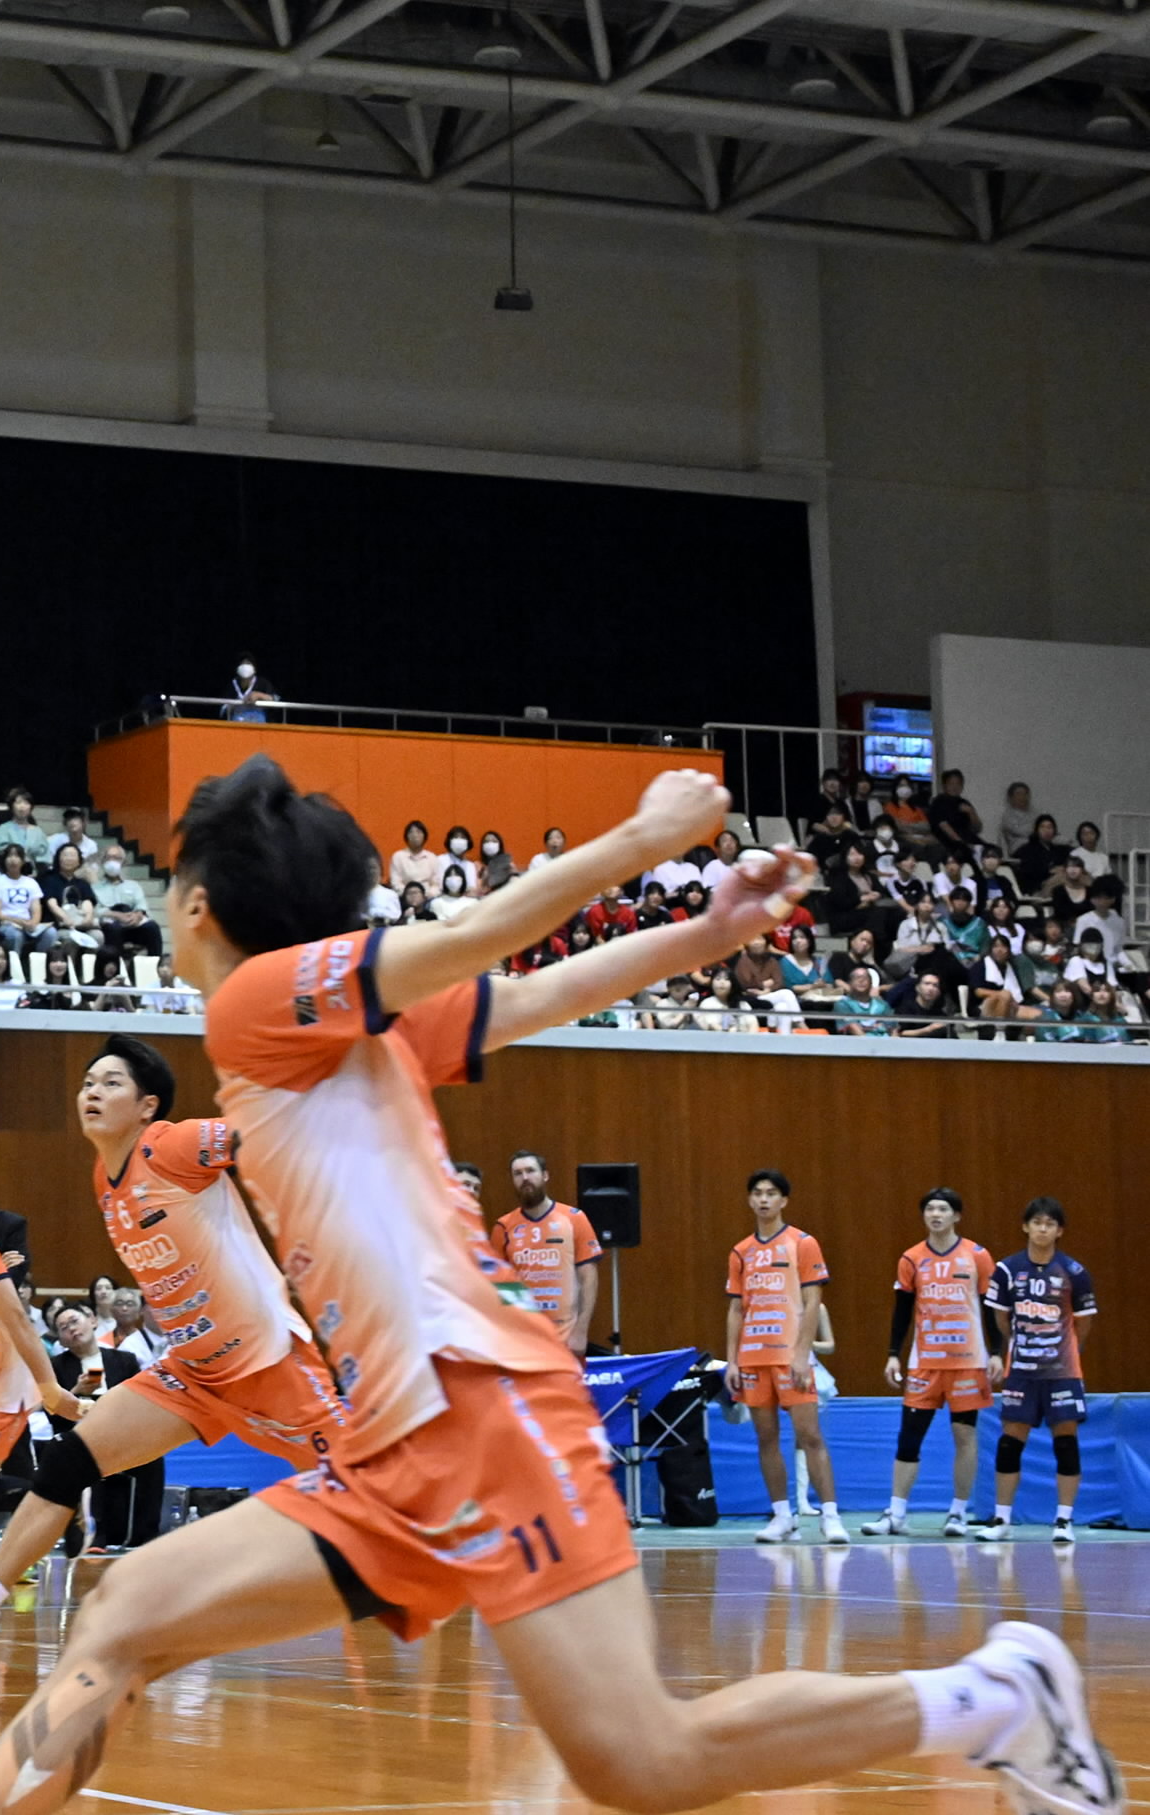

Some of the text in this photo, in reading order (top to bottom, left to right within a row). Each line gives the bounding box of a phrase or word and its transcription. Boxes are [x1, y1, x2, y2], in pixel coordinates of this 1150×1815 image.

[116, 1200, 134, 1230] 6
[531, 1226, 542, 1243] 3
[116, 1234, 179, 1272] ippn
[755, 1249, 772, 1267] 23
[934, 1261, 950, 1278] 17
[1029, 1278, 1046, 1297] 10
[311, 1431, 330, 1454] 6
[510, 1514, 563, 1574] 11
